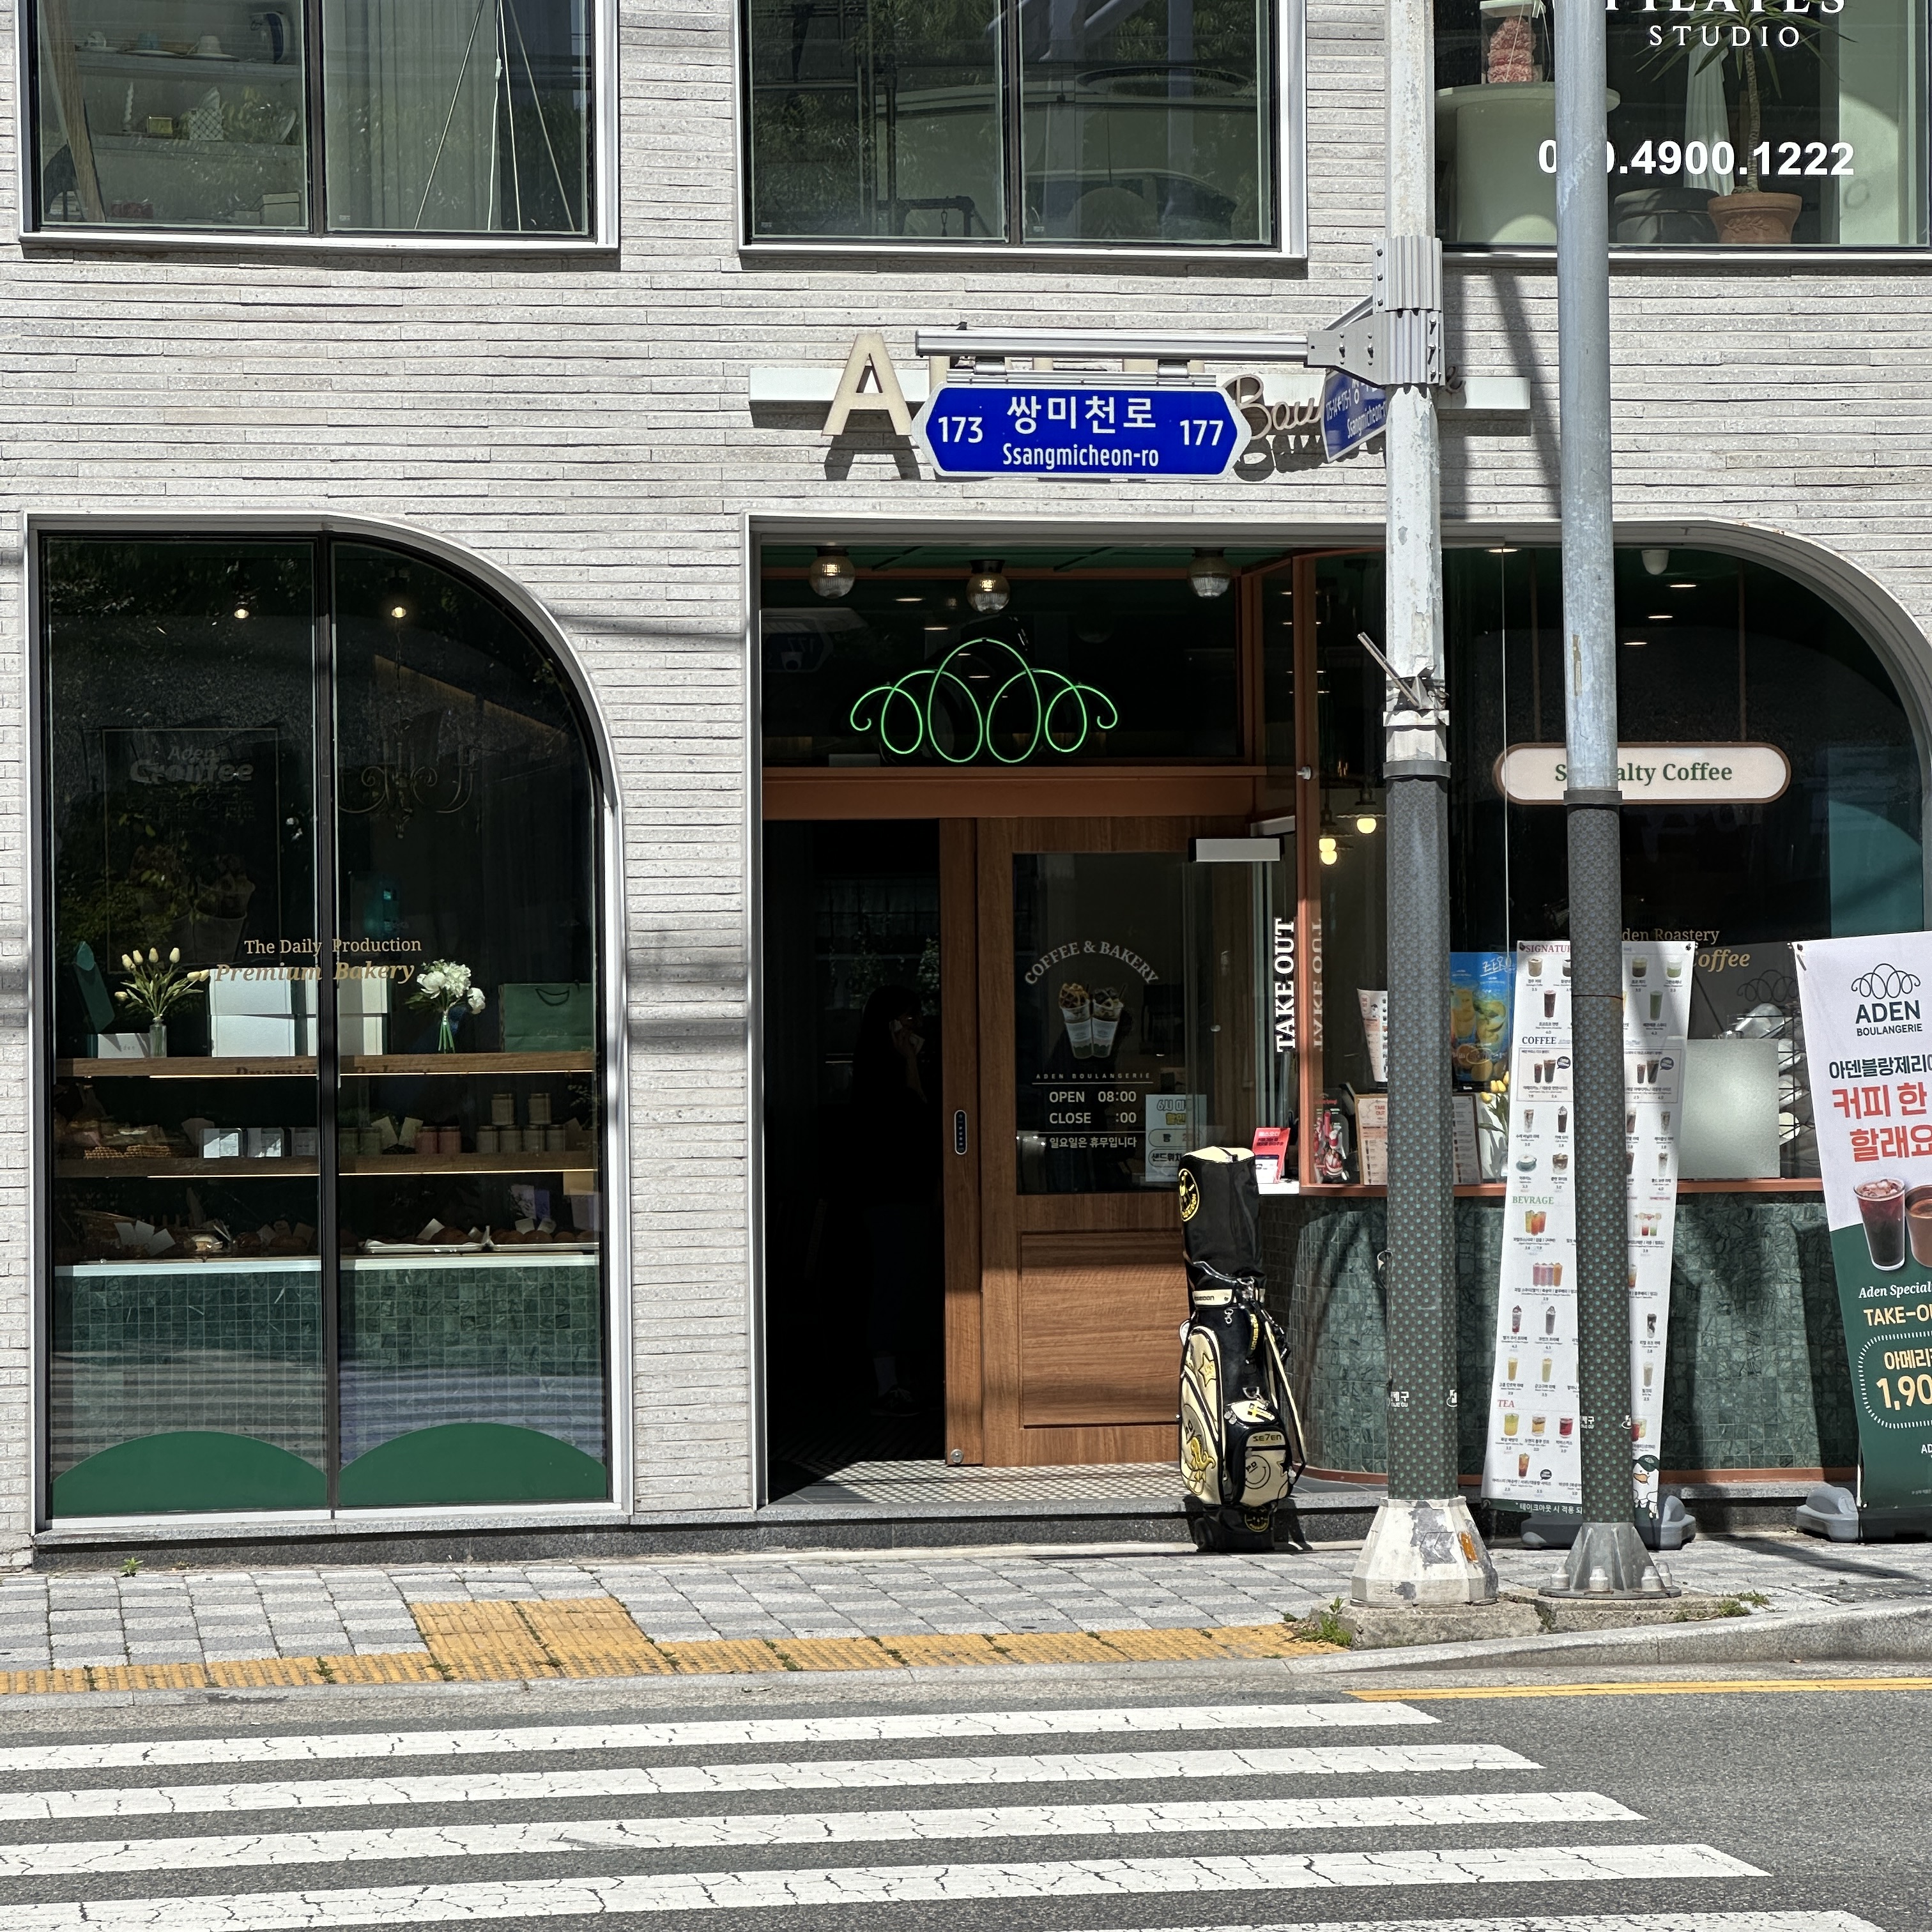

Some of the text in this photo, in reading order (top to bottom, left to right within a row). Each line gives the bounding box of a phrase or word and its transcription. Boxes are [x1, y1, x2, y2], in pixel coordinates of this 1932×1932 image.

[1649, 25, 1800, 47] STUDIO
[1538, 140, 1855, 176] 0.4900.1222
[1007, 395, 1157, 434] 쌍미천로
[938, 416, 984, 443] 173
[1180, 419, 1224, 446] 177
[1003, 443, 1160, 470] Ssangmicheon-ro
[1555, 762, 1733, 786] Salty Coffee
[244, 937, 422, 957] The Daily Production
[1655, 928, 1721, 946] Roastery
[215, 960, 415, 985] Premium Bakery
[1024, 940, 1160, 985] COFFEE & BAKERY
[1696, 949, 1751, 973] offee
[1274, 917, 1296, 1053] TAKE OUT
[1855, 1000, 1920, 1024] ADEN
[1857, 1023, 1923, 1037] BOULANGERIE
[1049, 1091, 1137, 1103] OPEN 08:00
[1832, 1082, 1928, 1121] 커피 한
[1049, 1112, 1092, 1124] CLOSE
[1050, 1137, 1137, 1149] 일요일은 휴무입니다
[1849, 1123, 1932, 1163] 할래요
[1512, 1196, 1554, 1204] BEVRAGE
[1859, 1281, 1932, 1299] Aden Special
[1498, 1400, 1515, 1408] TEA
[1519, 1503, 1552, 1513] 테이크아웃
